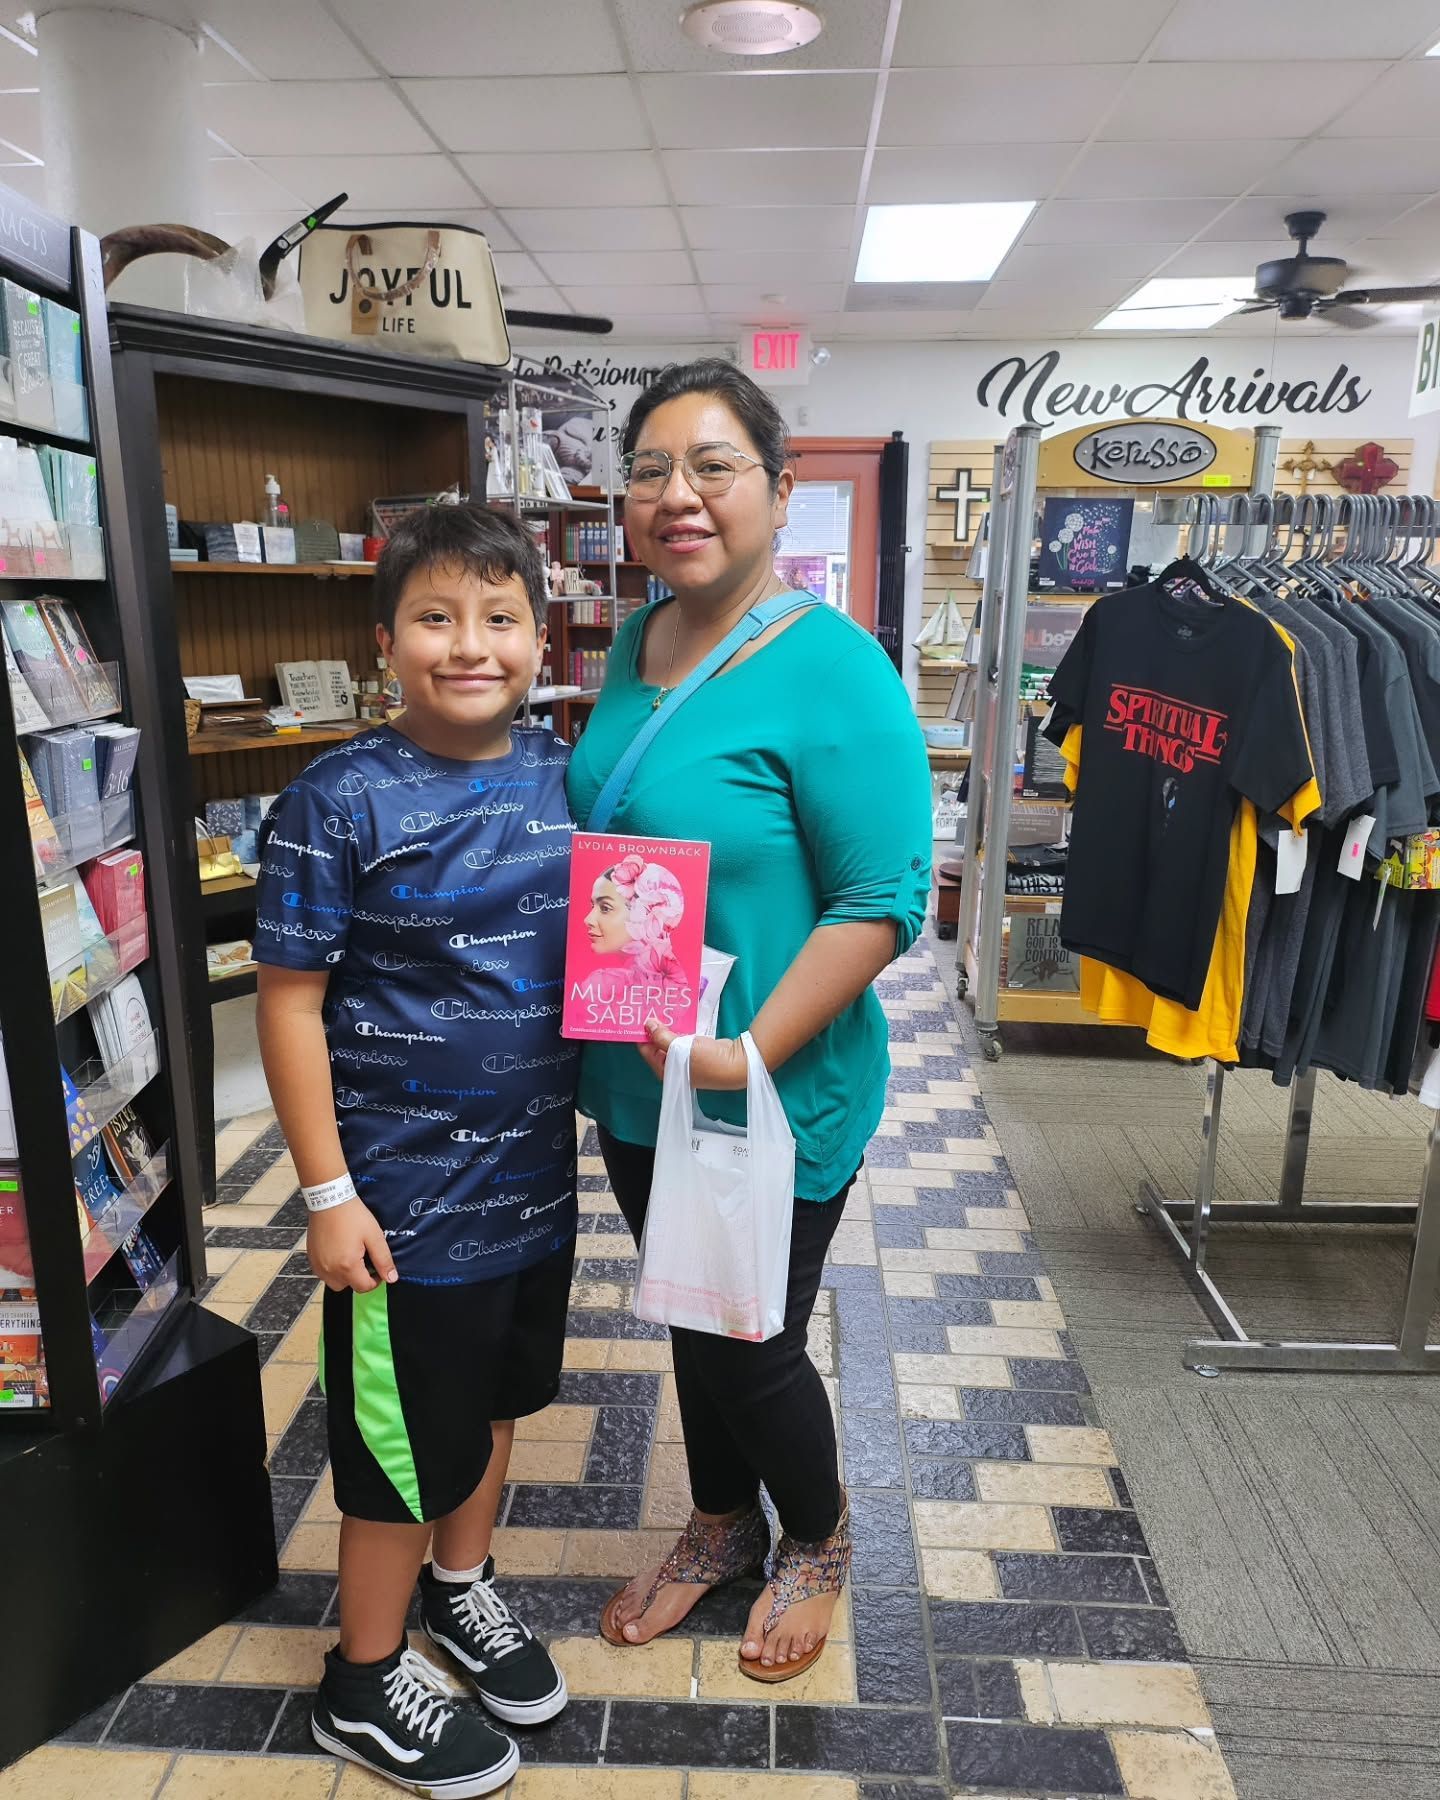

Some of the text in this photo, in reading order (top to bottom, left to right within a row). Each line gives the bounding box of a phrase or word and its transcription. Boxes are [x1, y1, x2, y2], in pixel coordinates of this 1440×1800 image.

[382, 317, 415, 333] LIFE
[753, 333, 800, 369] EXIT
[977, 350, 1371, 427] New Arrivals
[1106, 689, 1221, 757] SPIRITUAL
[1122, 722, 1194, 773] THINGS
[400, 801, 523, 832] Champion
[578, 841, 701, 857] LYDIA BROWNBACK
[391, 884, 485, 902] Champion
[450, 930, 537, 948] Champion
[1027, 918, 1062, 936] RELA
[1026, 937, 1058, 949] GOD IS
[1025, 949, 1071, 963] CONTROL
[571, 982, 691, 1008] MUJERES
[431, 998, 561, 1027] Champion
[586, 1003, 674, 1028] SABIAS
[355, 1021, 446, 1045] Champion
[402, 1080, 496, 1100] Champion
[451, 1128, 533, 1143] Champion
[410, 1191, 528, 1216] Champion
[519, 1191, 572, 1220] Champion
[448, 1223, 552, 1261] Champion
